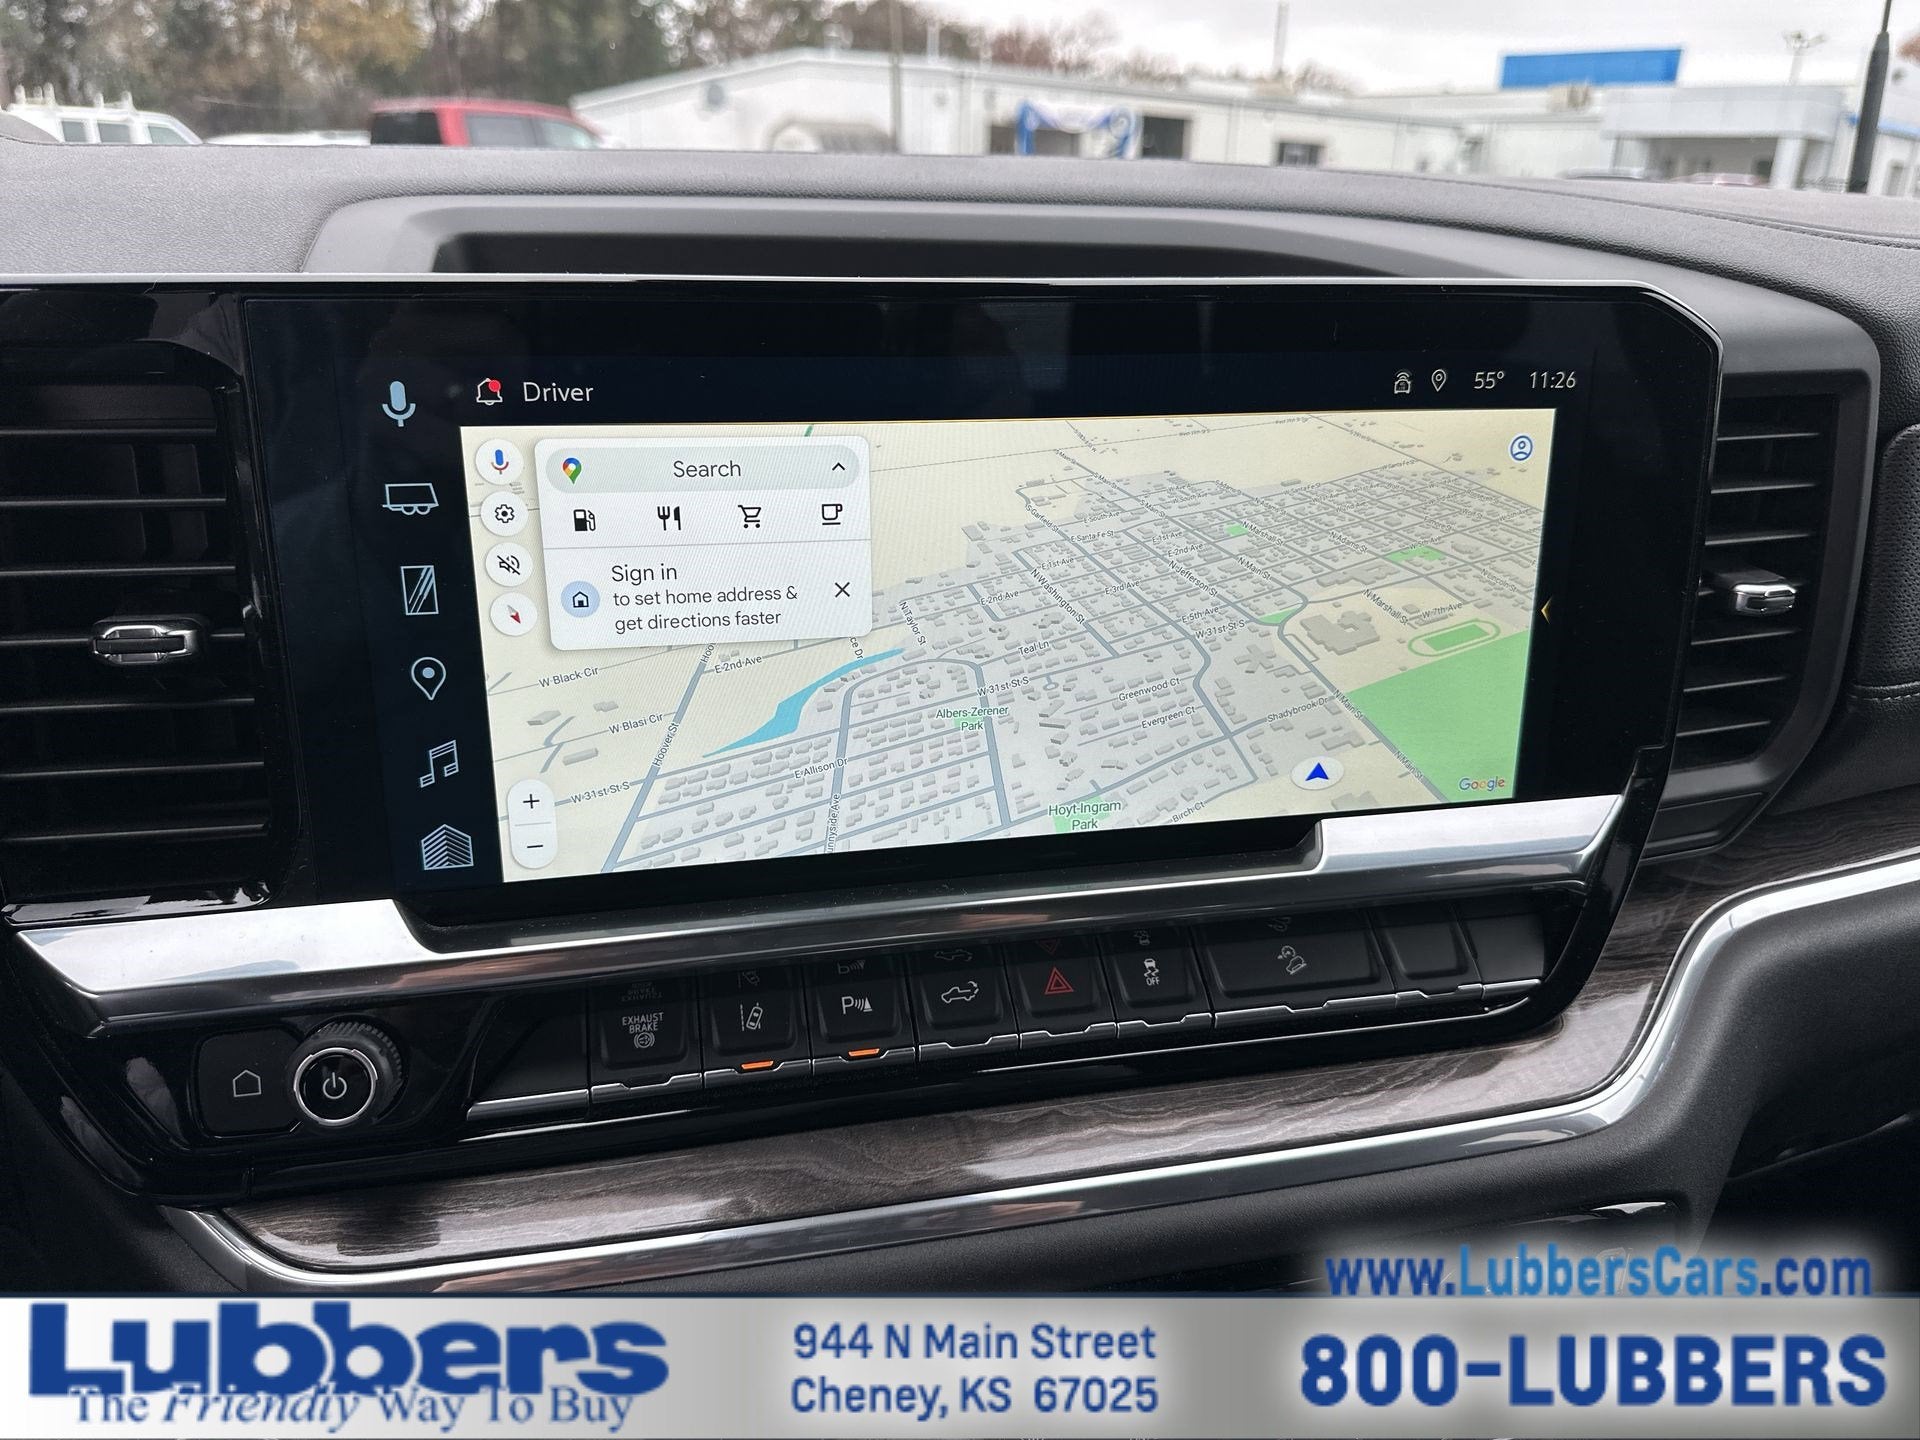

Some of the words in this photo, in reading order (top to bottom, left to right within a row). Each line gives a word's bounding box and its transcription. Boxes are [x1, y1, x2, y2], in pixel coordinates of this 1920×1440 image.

[1473, 371, 1505, 389] 55°
[1530, 371, 1577, 389] 11:26
[523, 381, 594, 403] Driver
[673, 459, 741, 479] Search
[1027, 504, 1032, 512] S
[1031, 507, 1054, 528] Garfield
[1051, 524, 1059, 533] St
[1083, 516, 1088, 524] E
[1088, 513, 1105, 523] South
[1105, 510, 1120, 519] Ave
[1076, 532, 1095, 542] Santa
[1096, 531, 1104, 539] Fe
[1106, 529, 1115, 538] St
[1158, 533, 1169, 541] 1st
[1169, 530, 1183, 539] Ave
[1243, 521, 1249, 529] N
[1250, 525, 1277, 543] Marshall
[1275, 538, 1284, 546] St
[1330, 531, 1336, 539] N
[1168, 550, 1173, 558] E
[1174, 546, 1189, 556] 2nd
[1190, 542, 1204, 552] Ave
[1048, 560, 1061, 569] 1st
[1061, 556, 1075, 566] Ave
[1238, 557, 1245, 565] N
[1244, 561, 1264, 579] Main
[1262, 571, 1271, 581] St
[611, 564, 655, 586] Sign
[660, 564, 678, 581] in
[1168, 560, 1176, 569] N
[1175, 566, 1211, 593] Jefferson
[1208, 588, 1218, 598] St
[1481, 568, 1487, 576] N
[1487, 572, 1509, 589] Lincoln
[1509, 584, 1517, 593] St
[613, 591, 630, 606] to
[634, 589, 661, 606] set
[665, 587, 713, 604] home
[717, 585, 781, 602] address
[786, 585, 798, 600] &
[1031, 568, 1039, 578] N
[1037, 575, 1078, 617] Washington
[1075, 614, 1085, 625] St
[1105, 587, 1110, 595] E
[1111, 583, 1125, 593] 3rd
[1126, 579, 1140, 589] Ave
[980, 598, 986, 606] E
[987, 593, 1004, 604] 2nd
[1004, 590, 1019, 600] Ave
[1364, 588, 1372, 598] N
[1371, 593, 1401, 620] Marshall
[1399, 614, 1409, 626] St
[1181, 616, 1187, 624] E
[1189, 611, 1204, 621] 5th
[1204, 607, 1219, 617] Ave
[1422, 611, 1430, 619] W
[1433, 607, 1446, 616] 7th
[1447, 601, 1463, 611] Ave
[615, 616, 644, 635] get
[648, 612, 731, 630] directions
[734, 610, 781, 627] faster
[900, 601, 907, 610] N
[904, 609, 920, 635] Taylor
[917, 635, 927, 646] St
[1195, 630, 1205, 639] W
[1207, 625, 1227, 636] 31st
[1228, 622, 1238, 631] St
[1239, 619, 1245, 628] S
[855, 648, 864, 659] Dr
[1018, 645, 1036, 656] Teal
[1038, 641, 1049, 650] Ln
[714, 665, 721, 674] E
[722, 660, 742, 672] 2nd
[744, 655, 762, 668] Ave
[538, 678, 550, 689] W
[553, 670, 582, 686] Black
[583, 666, 599, 678] Cir
[977, 687, 987, 697] W
[989, 681, 1010, 694] 31st
[1011, 678, 1020, 687] St
[1023, 676, 1029, 685] S
[1119, 681, 1168, 702] Greenwood
[1170, 678, 1180, 688] Ct
[935, 706, 1009, 719] Albers-Zerener
[1267, 700, 1316, 722] Shadybrook
[1319, 697, 1328, 706] Dr
[1334, 689, 1340, 698] N
[1339, 696, 1357, 714] Main
[1355, 711, 1363, 720] St
[609, 724, 619, 734] W
[622, 718, 647, 732] Blasi
[649, 713, 664, 724] Cir
[961, 721, 984, 731] Park
[1141, 711, 1184, 729] Evergreen
[1185, 706, 1195, 715] Ct
[652, 733, 673, 767] Hoover
[668, 722, 680, 734] St
[794, 770, 801, 779] E
[804, 762, 835, 777] Allison
[836, 757, 848, 768] Dr
[1394, 750, 1402, 759] N
[1401, 756, 1416, 774] Main
[1414, 770, 1424, 780] St
[571, 794, 581, 804] W
[584, 788, 607, 801] 31st
[611, 784, 621, 794] St
[624, 781, 630, 790] S
[1459, 776, 1505, 791] Google
[831, 794, 840, 811] Ave
[1049, 802, 1121, 817] Hoyt-Ingram
[1172, 807, 1193, 823] Birch
[1194, 801, 1204, 810] Ct
[1072, 819, 1098, 830] Park
[1146, 976, 1160, 986] OFF
[622, 1012, 664, 1026] EXHAUST
[629, 1021, 658, 1034] BRAKE
